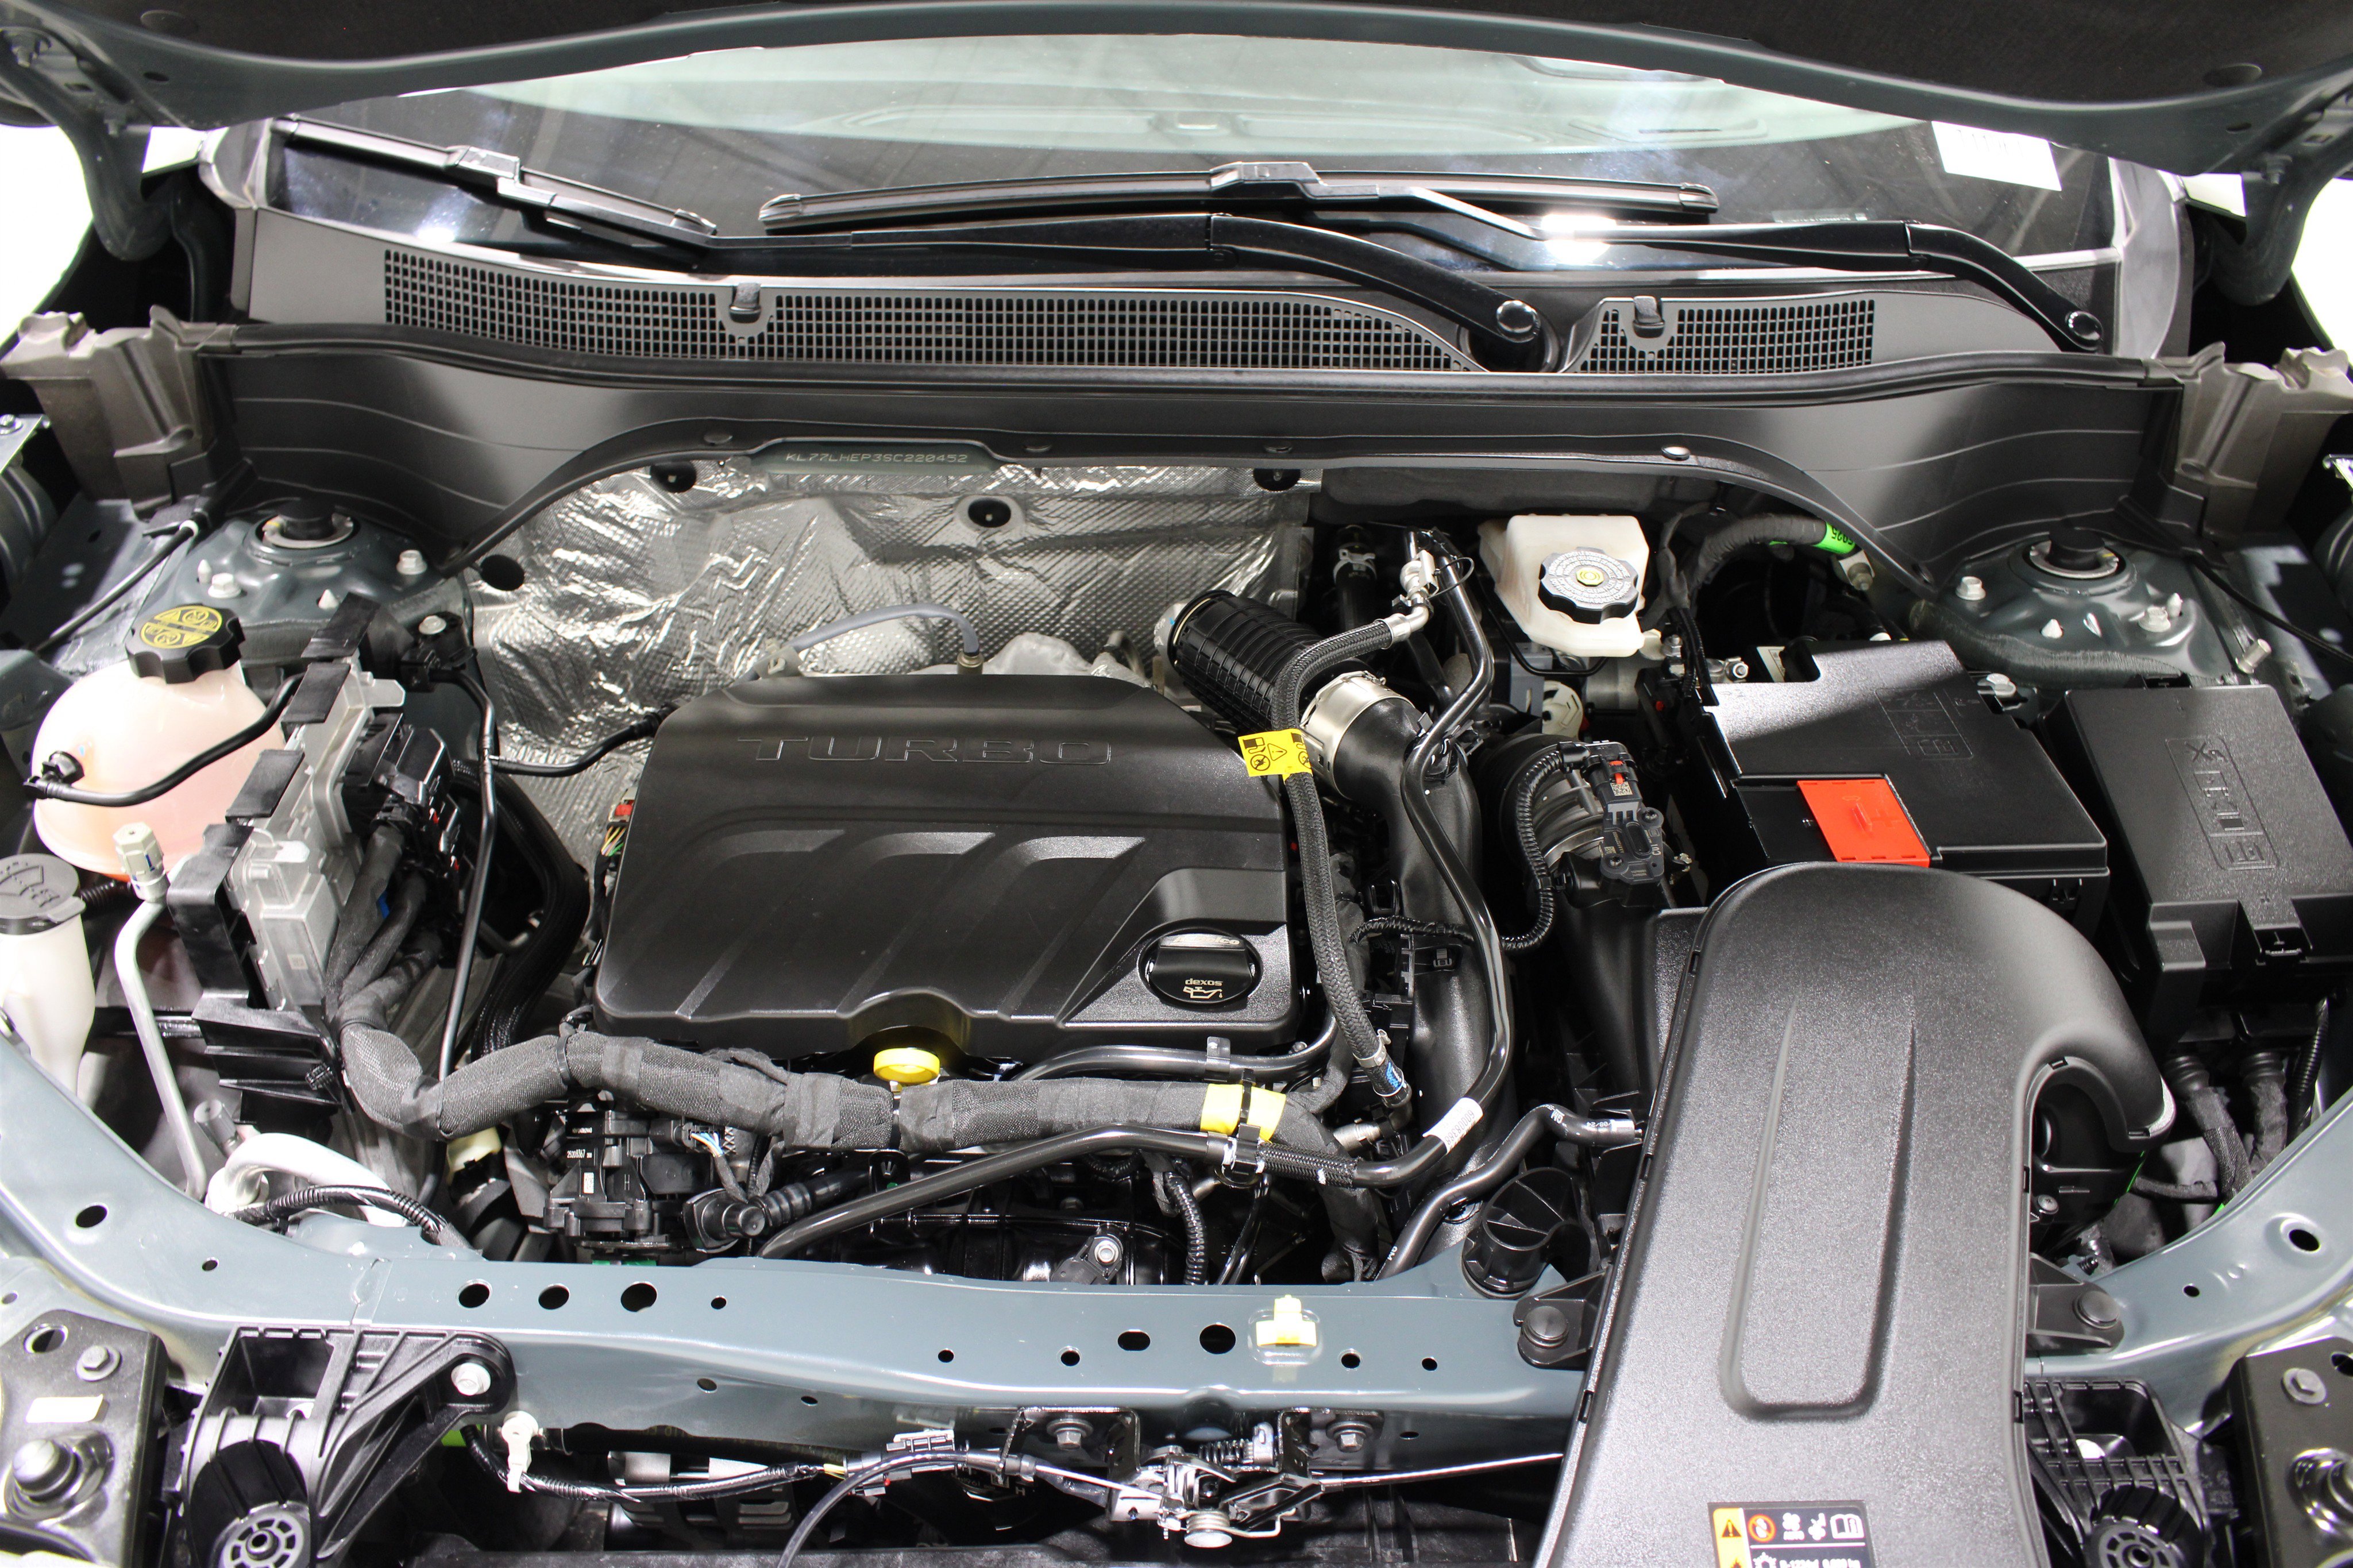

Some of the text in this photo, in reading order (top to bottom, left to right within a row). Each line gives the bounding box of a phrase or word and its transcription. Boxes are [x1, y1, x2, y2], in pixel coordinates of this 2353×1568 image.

[785, 453, 969, 463] KL77LHEP3SC220452
[737, 735, 1113, 765] TURBO
[1185, 978, 1224, 986] dexos
